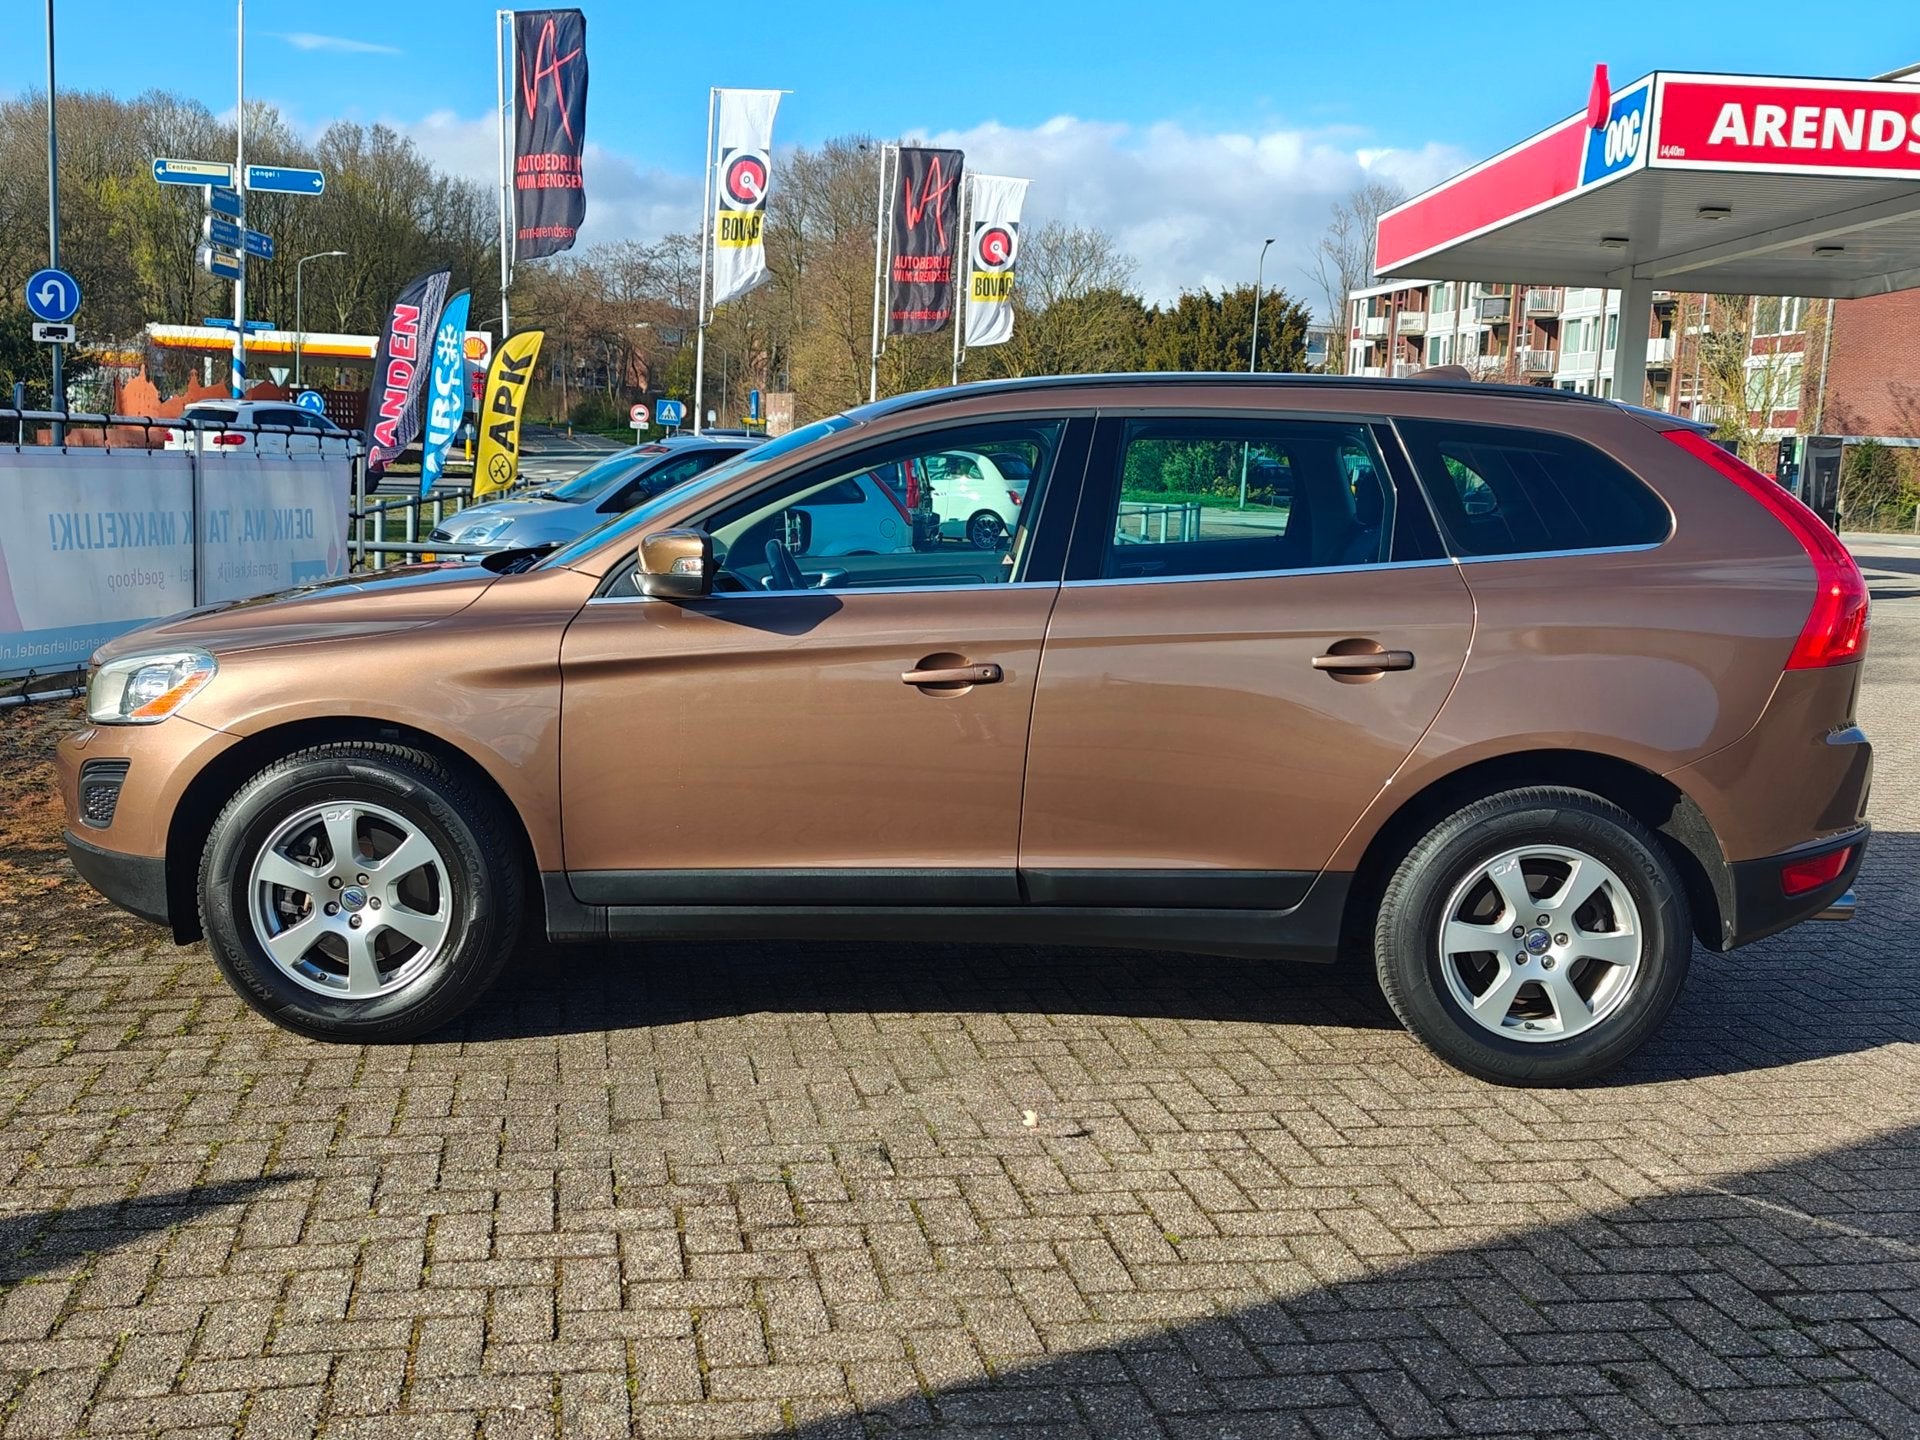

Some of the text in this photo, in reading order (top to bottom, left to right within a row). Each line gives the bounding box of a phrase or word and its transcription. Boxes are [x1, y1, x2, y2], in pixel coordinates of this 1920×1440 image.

[167, 163, 198, 172] Centrum
[517, 174, 536, 190] WIM
[721, 216, 760, 241] BOVAG
[894, 255, 950, 269] AUTOBEDRIJF
[893, 270, 913, 282] WIM
[975, 277, 1013, 297] BOVAG
[489, 350, 533, 453] APK
